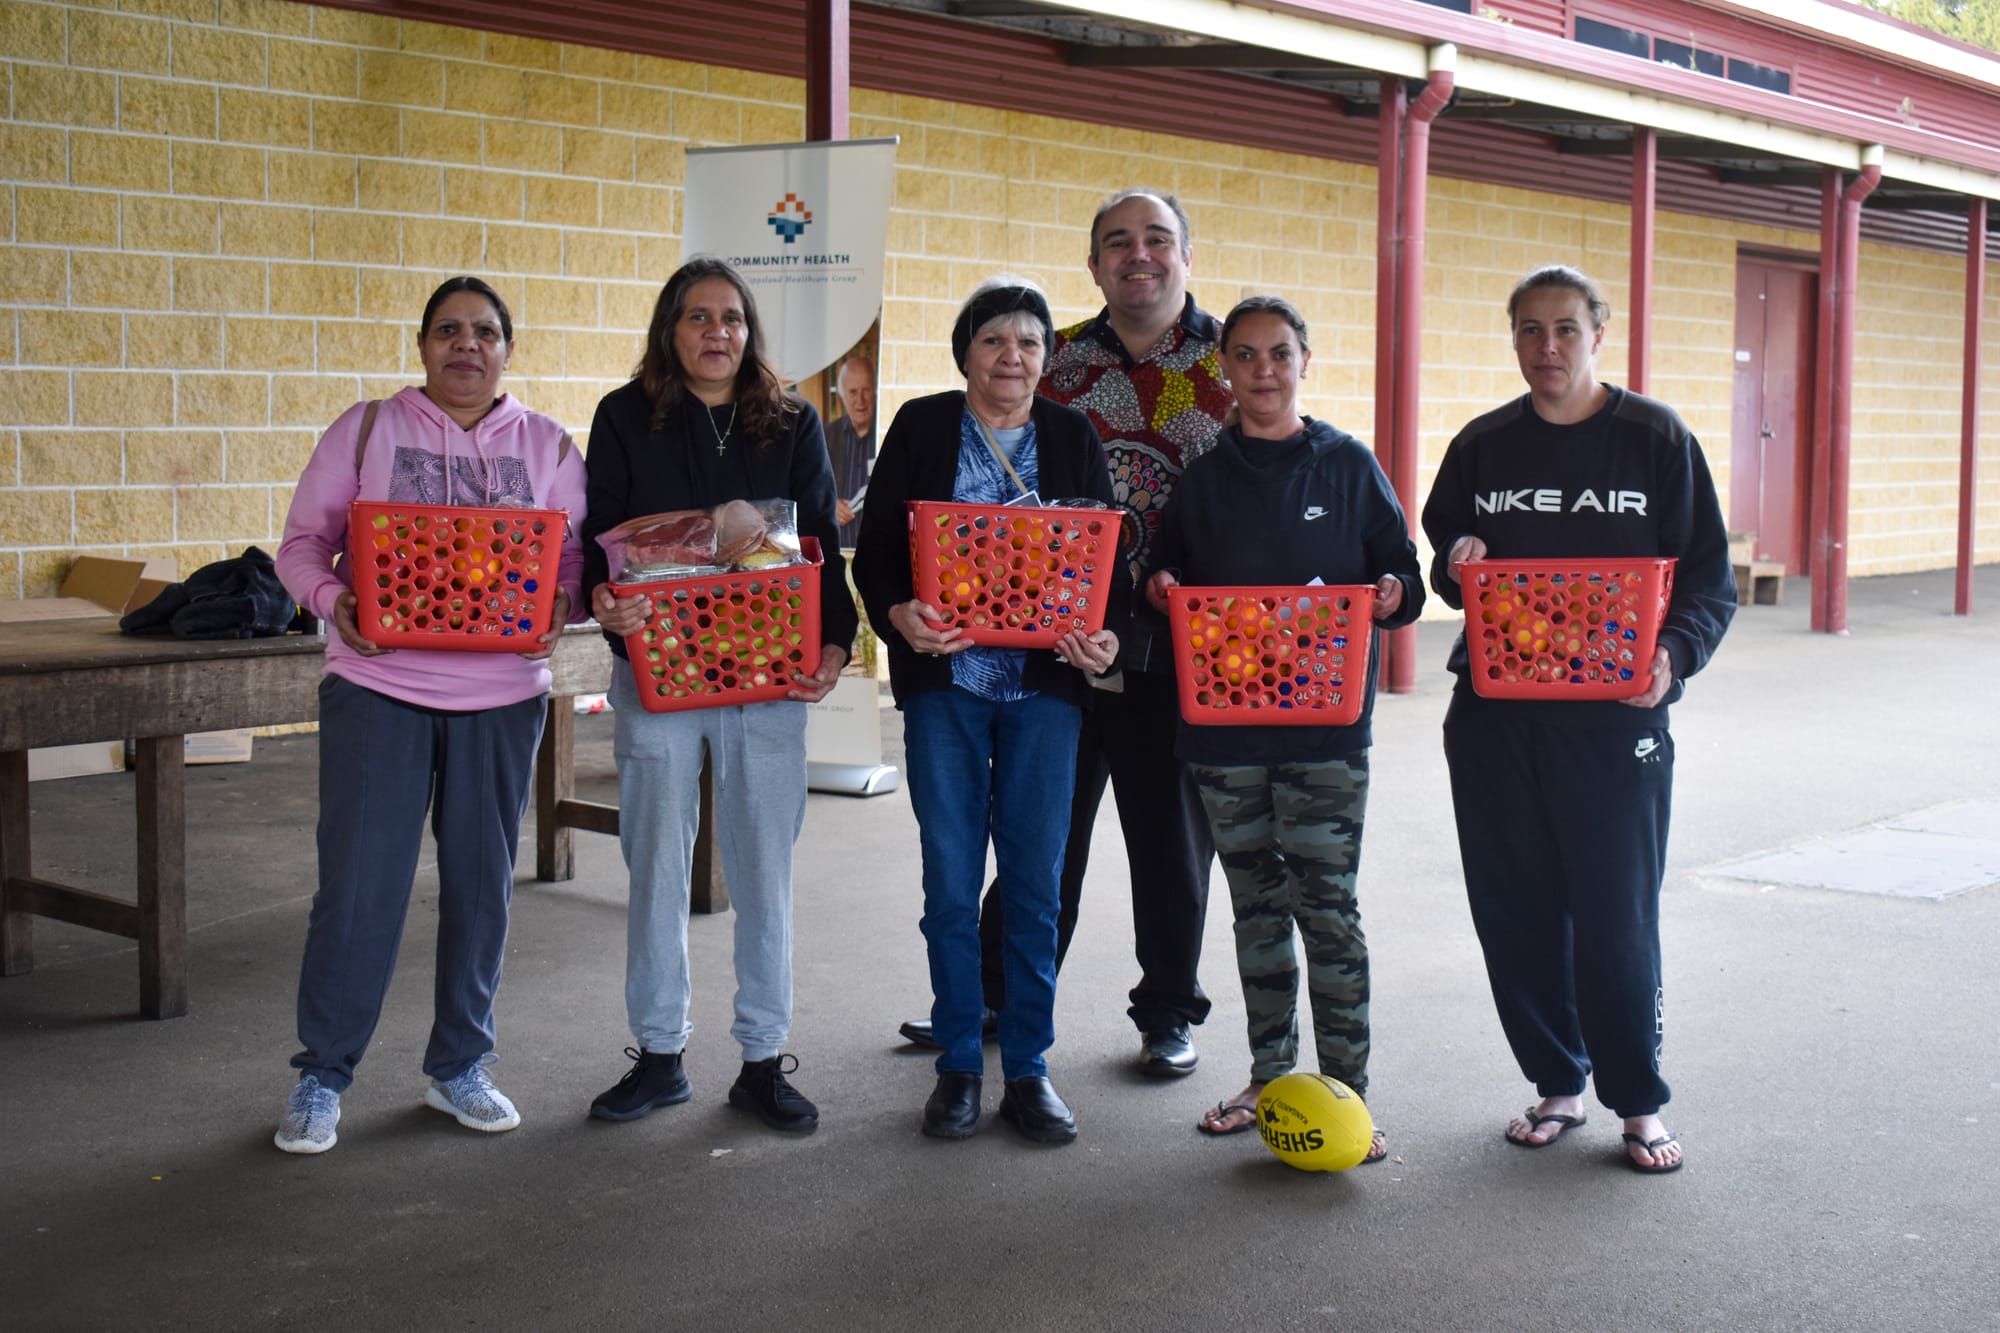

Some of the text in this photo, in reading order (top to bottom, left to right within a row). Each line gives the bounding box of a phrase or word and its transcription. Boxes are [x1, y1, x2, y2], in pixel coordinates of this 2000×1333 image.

[804, 254, 850, 265] HEALTH
[1475, 488, 1648, 517] NIKE AIR
